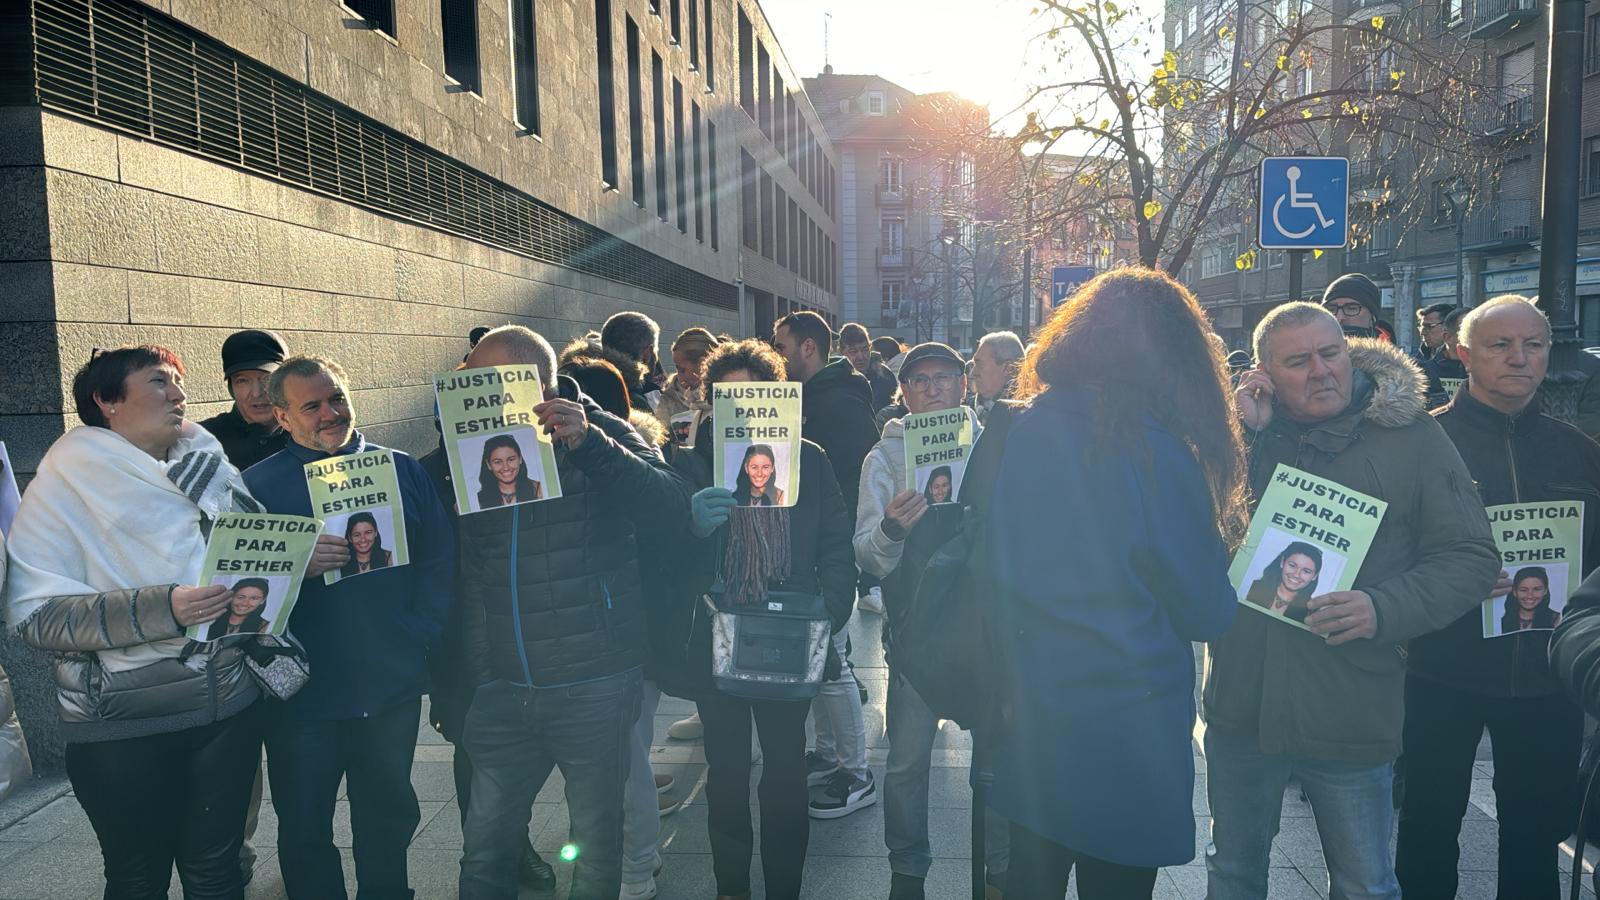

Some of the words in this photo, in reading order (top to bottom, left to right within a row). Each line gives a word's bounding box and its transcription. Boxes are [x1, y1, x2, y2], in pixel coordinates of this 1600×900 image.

[1055, 281, 1083, 295] TA
[436, 370, 536, 393] #JUSTICIA
[463, 392, 516, 411] PARA
[714, 387, 799, 399] #JUSTICIA
[735, 407, 779, 418] PARA
[455, 412, 531, 434] ESTHER
[904, 412, 970, 431] #JUSTICIA
[725, 427, 789, 438] ESTHER
[922, 432, 955, 446] PARA
[915, 448, 963, 464] ESTHER
[306, 454, 391, 480] #JUSTICIA
[328, 475, 374, 493] PARA
[322, 491, 388, 514] ESTHER
[1276, 471, 1378, 519] #JUSTICIA
[1292, 498, 1345, 527] PARA
[1489, 506, 1580, 522] JUSTICIA
[214, 517, 317, 534] #JUSTICIA
[1271, 512, 1351, 552] ESTHER
[1502, 528, 1554, 541] PARA
[234, 538, 287, 552] PARA
[216, 559, 294, 572] ESTHER
